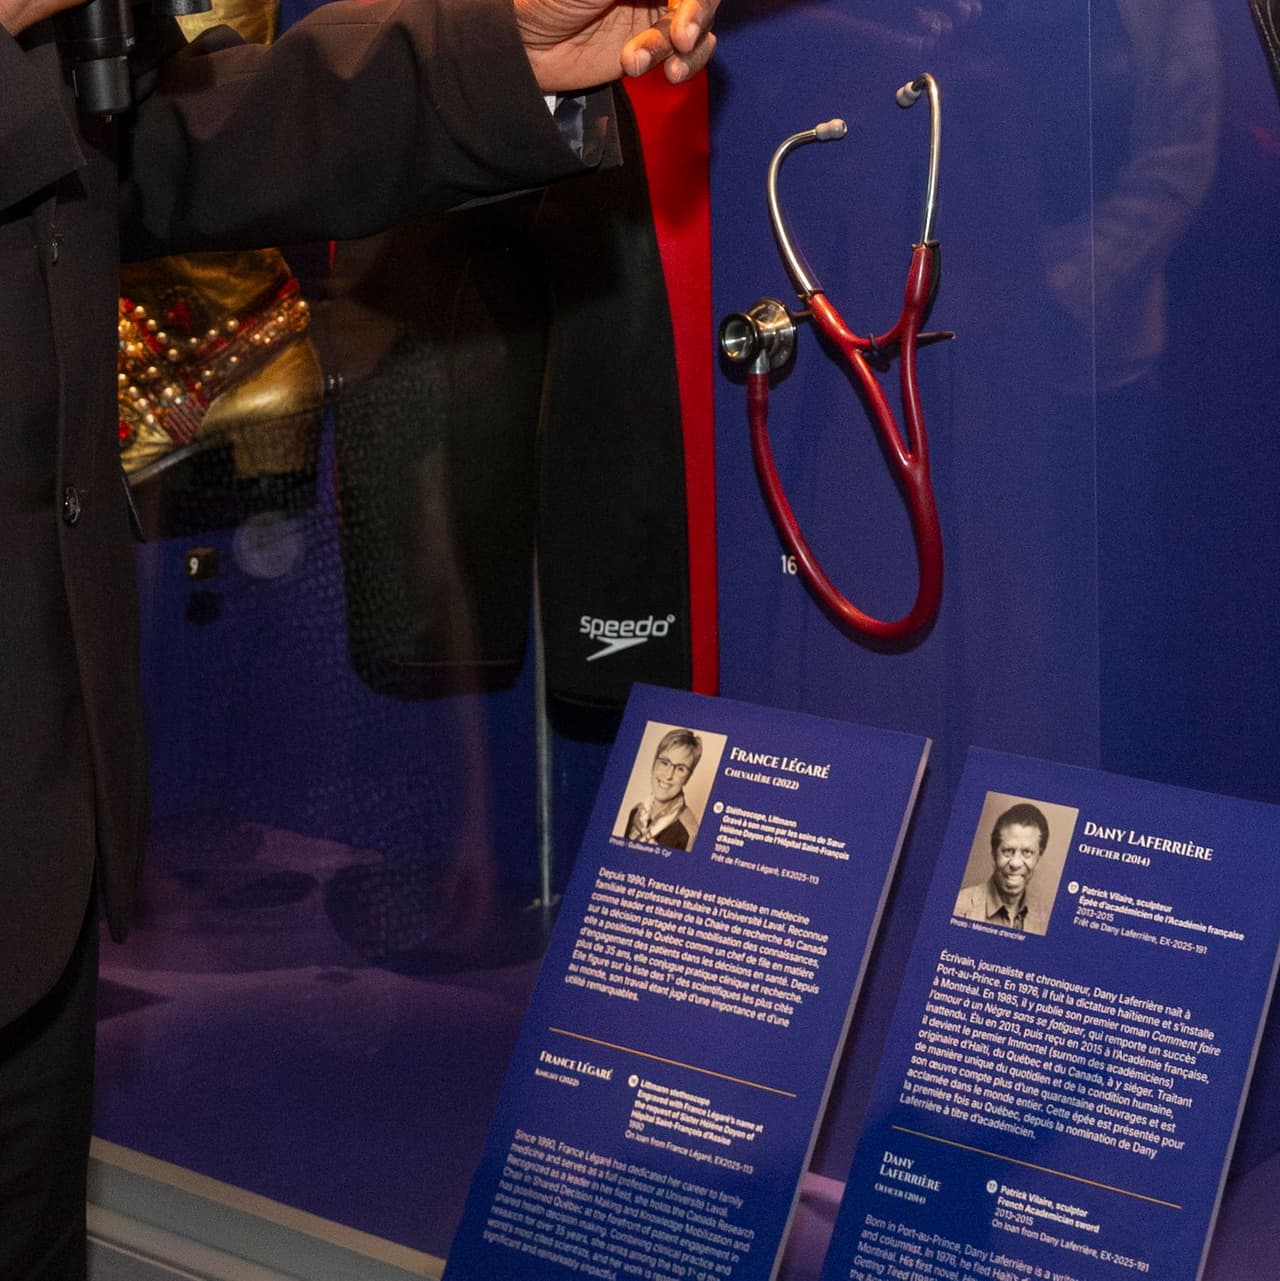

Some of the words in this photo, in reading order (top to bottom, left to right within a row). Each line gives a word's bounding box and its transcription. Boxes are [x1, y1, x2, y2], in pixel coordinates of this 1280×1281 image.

[190, 557, 199, 576] 9
[781, 555, 797, 575] 16
[580, 615, 670, 639] speedo
[730, 747, 780, 768] FRANCE
[780, 757, 831, 779] LÉGARÉ
[1084, 821, 1125, 842] DANY
[1128, 830, 1213, 861] LAFERRIÈRE
[1079, 844, 1120, 860] OFFICIER
[1121, 853, 1150, 867] (2014)
[1076, 906, 1114, 922] 2013-2015
[940, 950, 975, 969] Écrivain,
[977, 959, 1024, 979] journaliste
[1025, 972, 1035, 982] et
[1036, 974, 1090, 997] chroniqueur,
[1093, 987, 1118, 1003] Dany
[1118, 993, 1164, 1013] Laferrière
[1164, 1006, 1183, 1018] naît
[1184, 1009, 1191, 1020] à
[936, 963, 1000, 987] Port-au-Prince.
[1004, 979, 1016, 991] En
[1018, 983, 1039, 998] 1976,
[1042, 988, 1049, 999] il
[1049, 990, 1065, 1003] fuit
[1065, 994, 1074, 1005] la
[1076, 998, 1116, 1016] dictature
[1117, 1007, 1161, 1027] haïtienne
[1162, 1020, 1172, 1030] et
[1173, 1022, 1215, 1040] s'installe
[933, 976, 939, 986] à
[940, 977, 980, 996] Montréal.
[982, 988, 995, 999] En
[997, 991, 1018, 1007] 1985,
[1021, 997, 1028, 1008] il
[1027, 1001, 1035, 1011] y
[1035, 1003, 1064, 1017] publie
[1065, 1010, 1082, 1021] son
[1083, 1015, 1119, 1030] premier
[1120, 1024, 1150, 1038] roman
[1151, 1030, 1198, 1051] Comment
[1197, 1042, 1221, 1056] faire
[883, 1151, 914, 1169] DANY
[880, 1164, 941, 1191] LAFERRIÈRE
